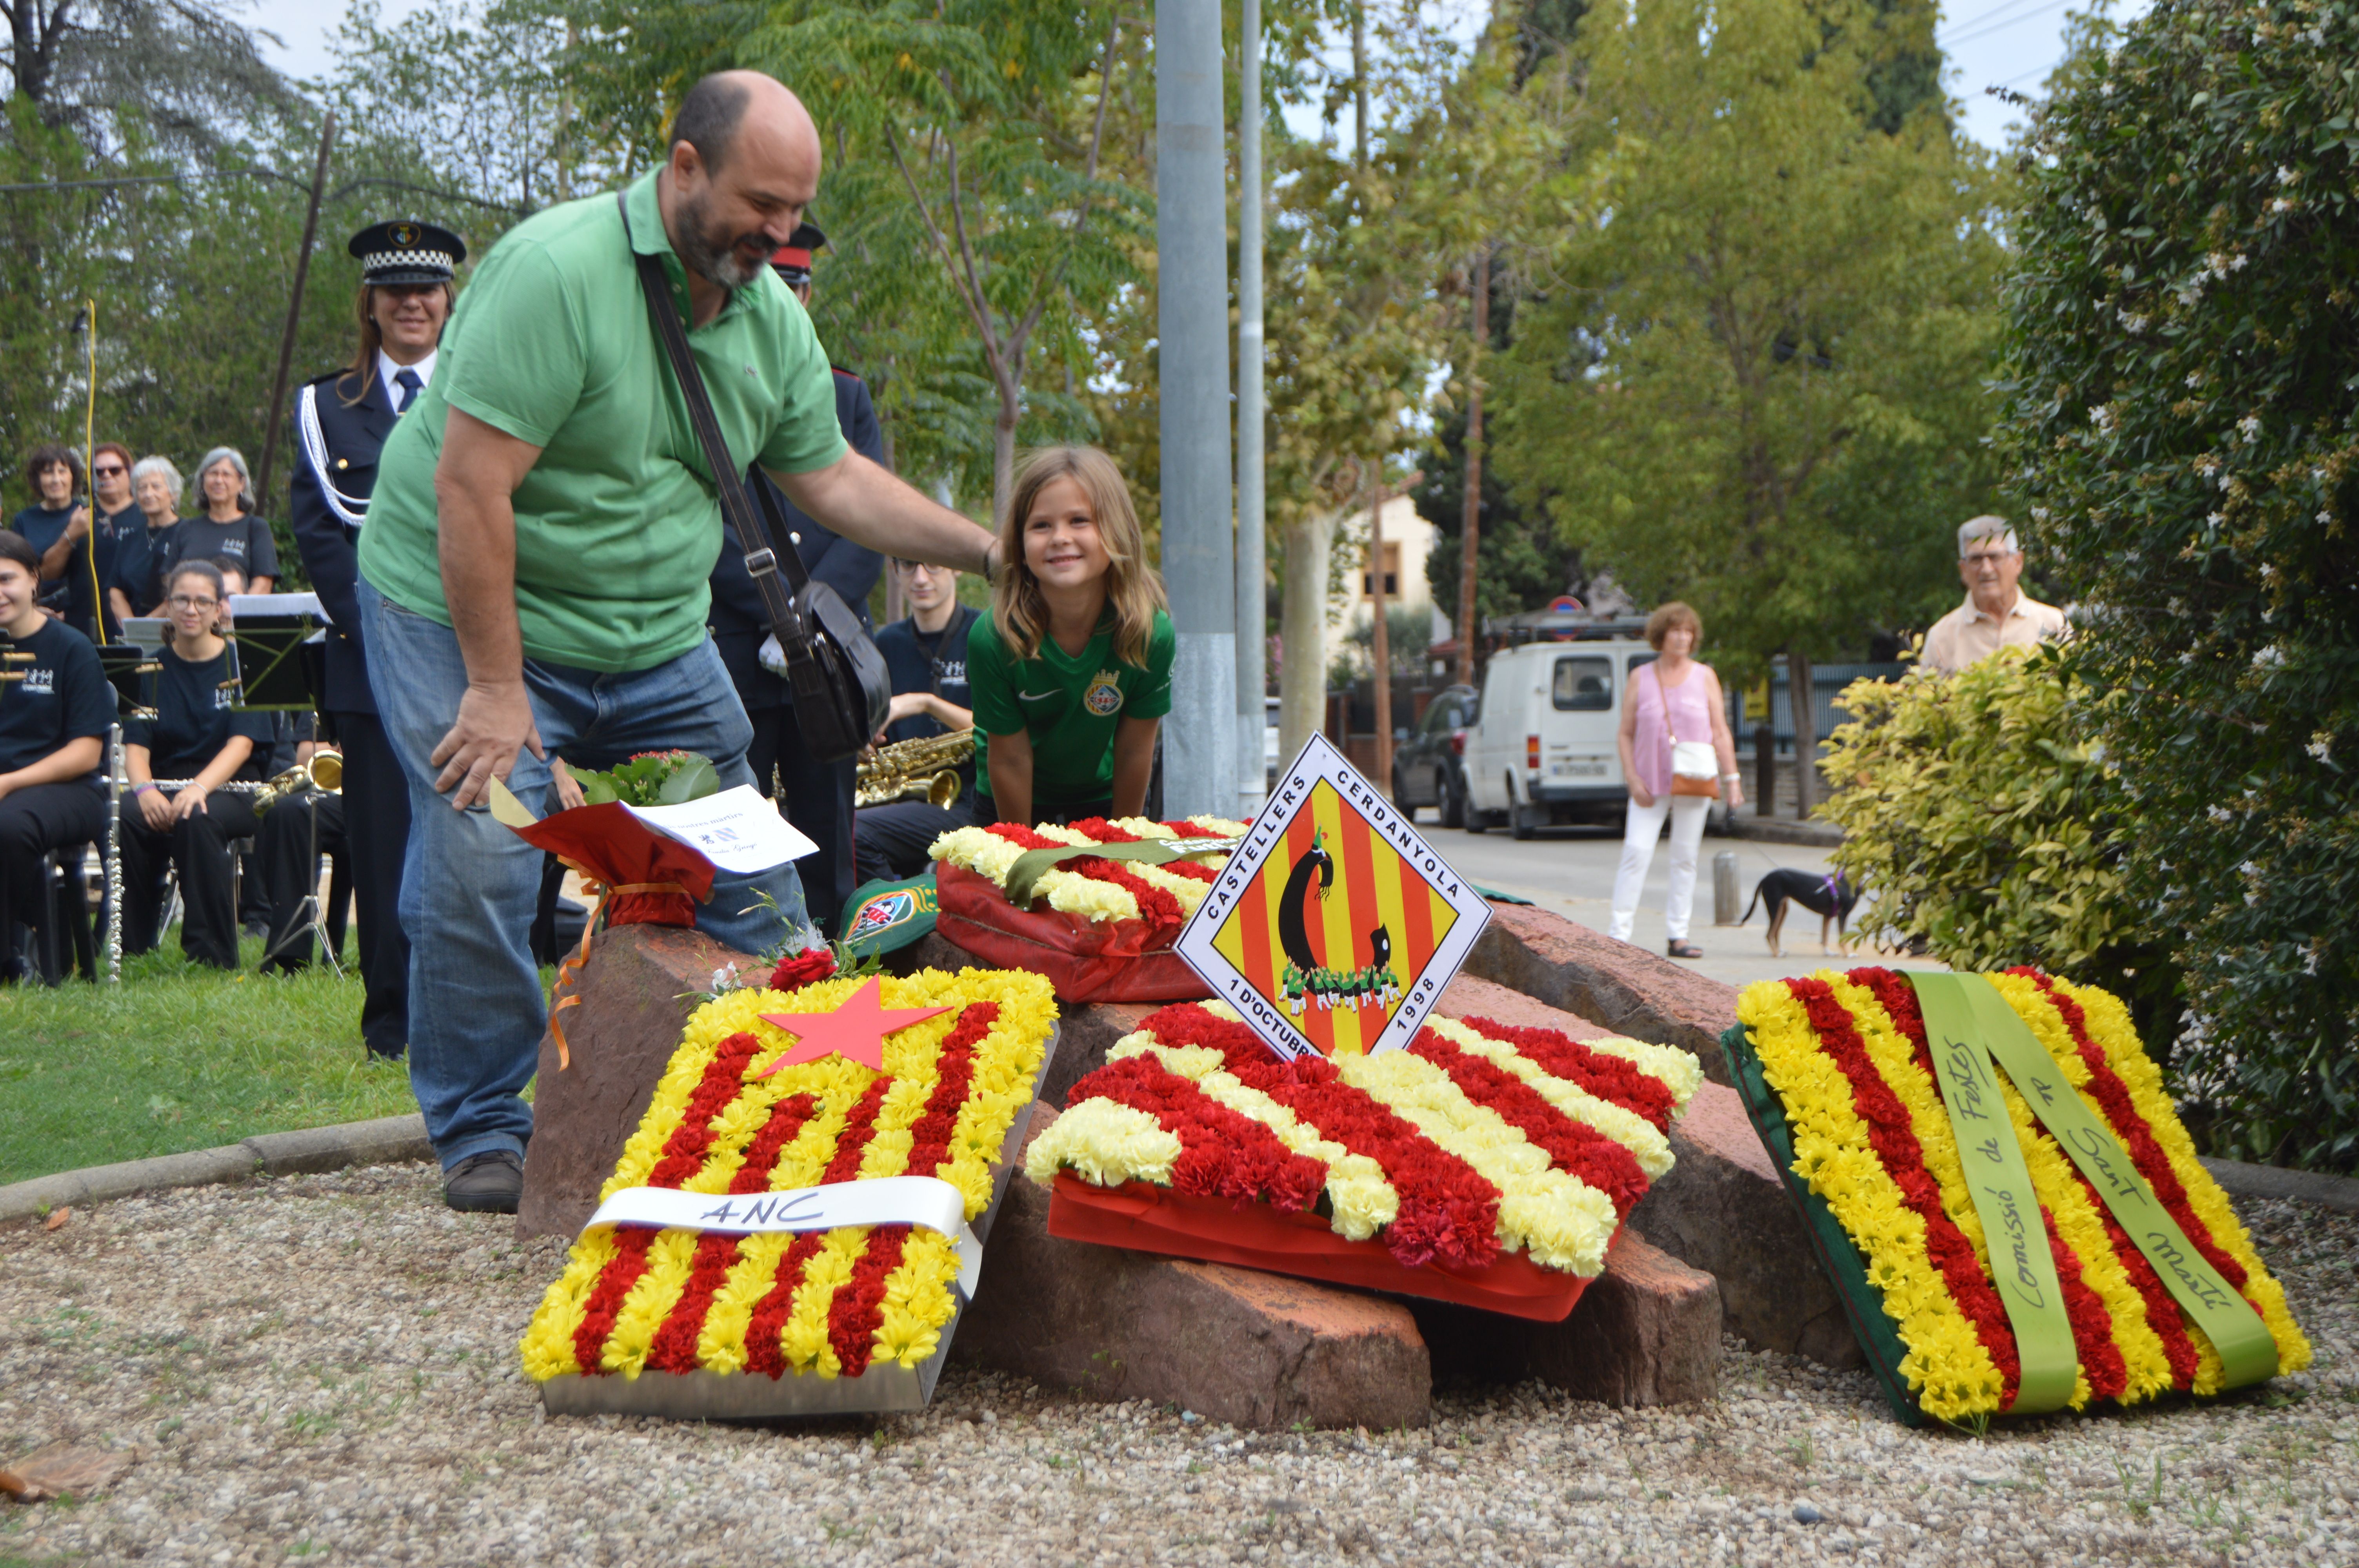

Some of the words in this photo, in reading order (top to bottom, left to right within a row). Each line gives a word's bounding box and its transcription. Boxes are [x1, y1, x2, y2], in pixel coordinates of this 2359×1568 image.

[1207, 775, 1305, 920] CASTELLERS
[1338, 770, 1458, 898] CERDANYOLA
[1230, 979, 1239, 991] 1
[1239, 988, 1313, 1056] D'OCTUBR
[1396, 978, 1434, 1031] 1998
[1943, 1035, 1990, 1121] Festes
[2030, 1076, 2054, 1107] de
[1976, 1137, 2003, 1163] de
[700, 1192, 823, 1224] ANC
[1984, 1186, 2045, 1308] Comissió
